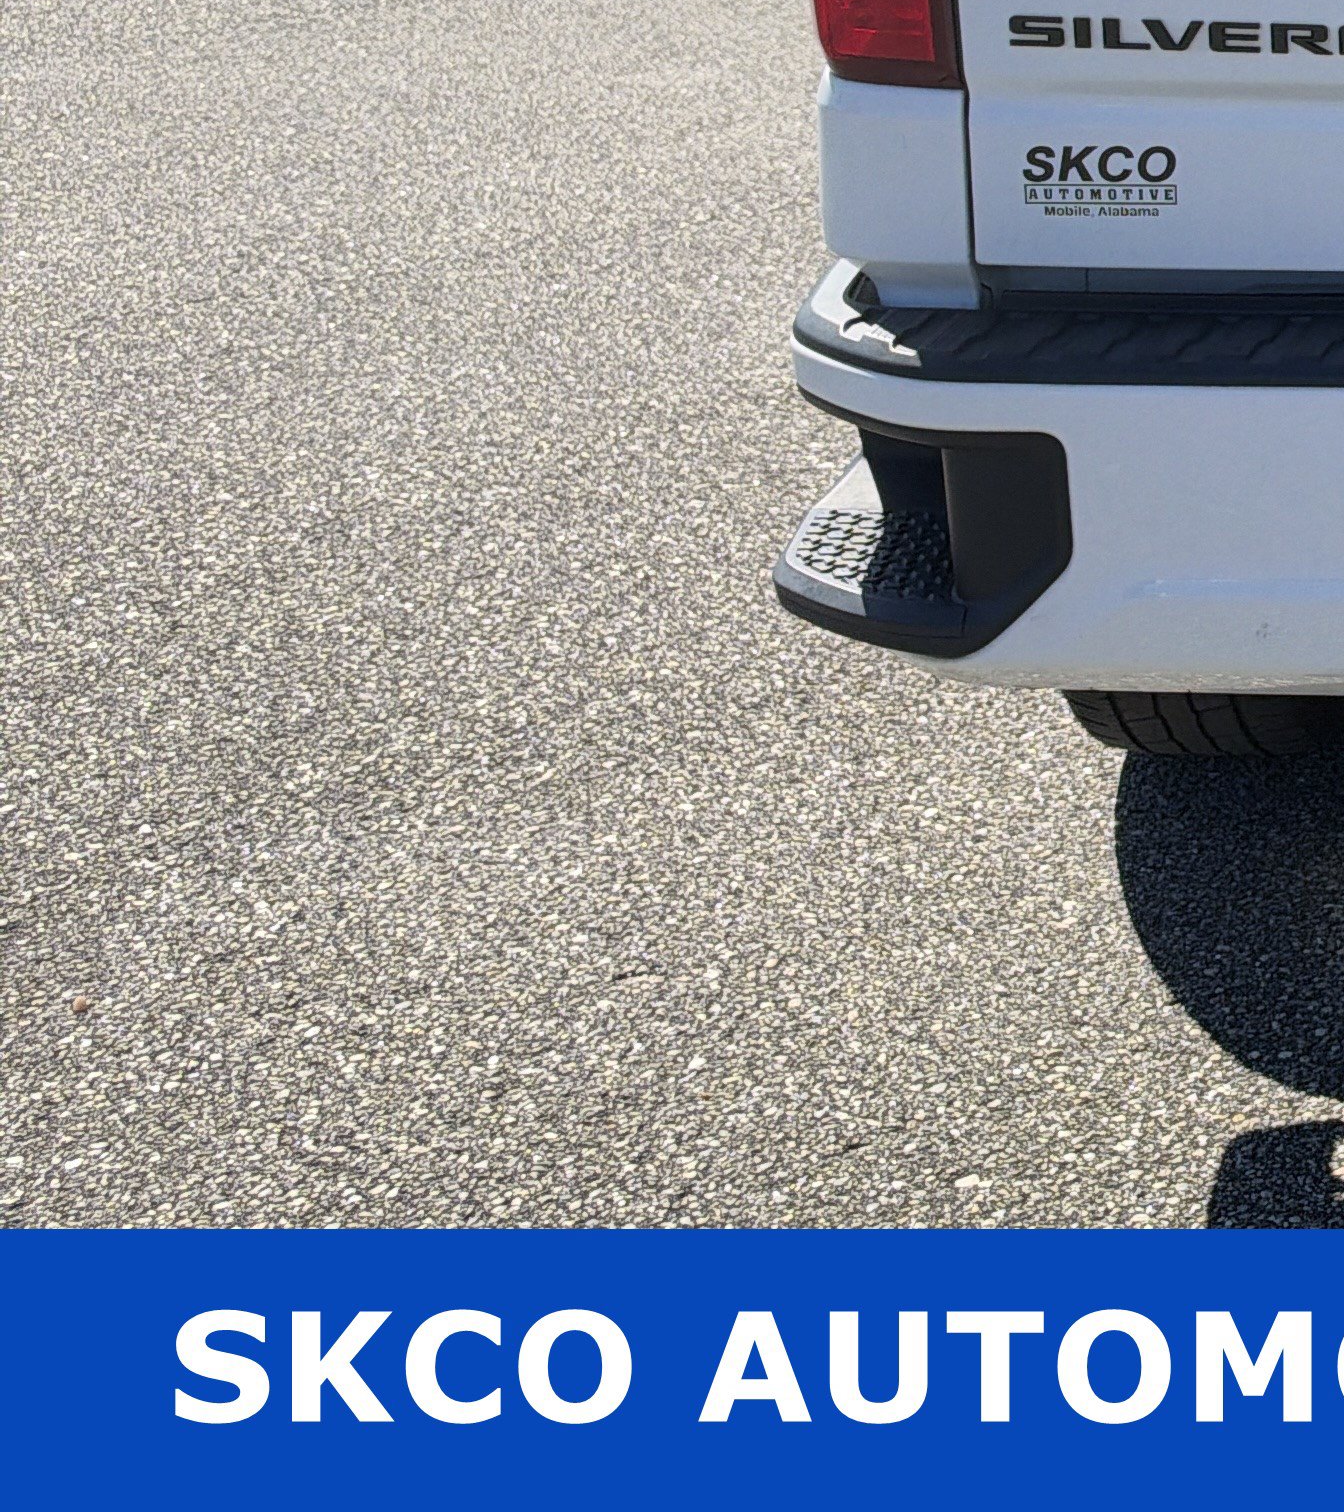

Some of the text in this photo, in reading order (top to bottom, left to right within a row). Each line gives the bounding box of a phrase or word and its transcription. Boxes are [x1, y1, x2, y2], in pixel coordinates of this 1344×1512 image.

[1023, 145, 1177, 182] SKCO
[1029, 188, 1174, 200] AUTOMOTIVE
[1098, 206, 1159, 216] Alabama
